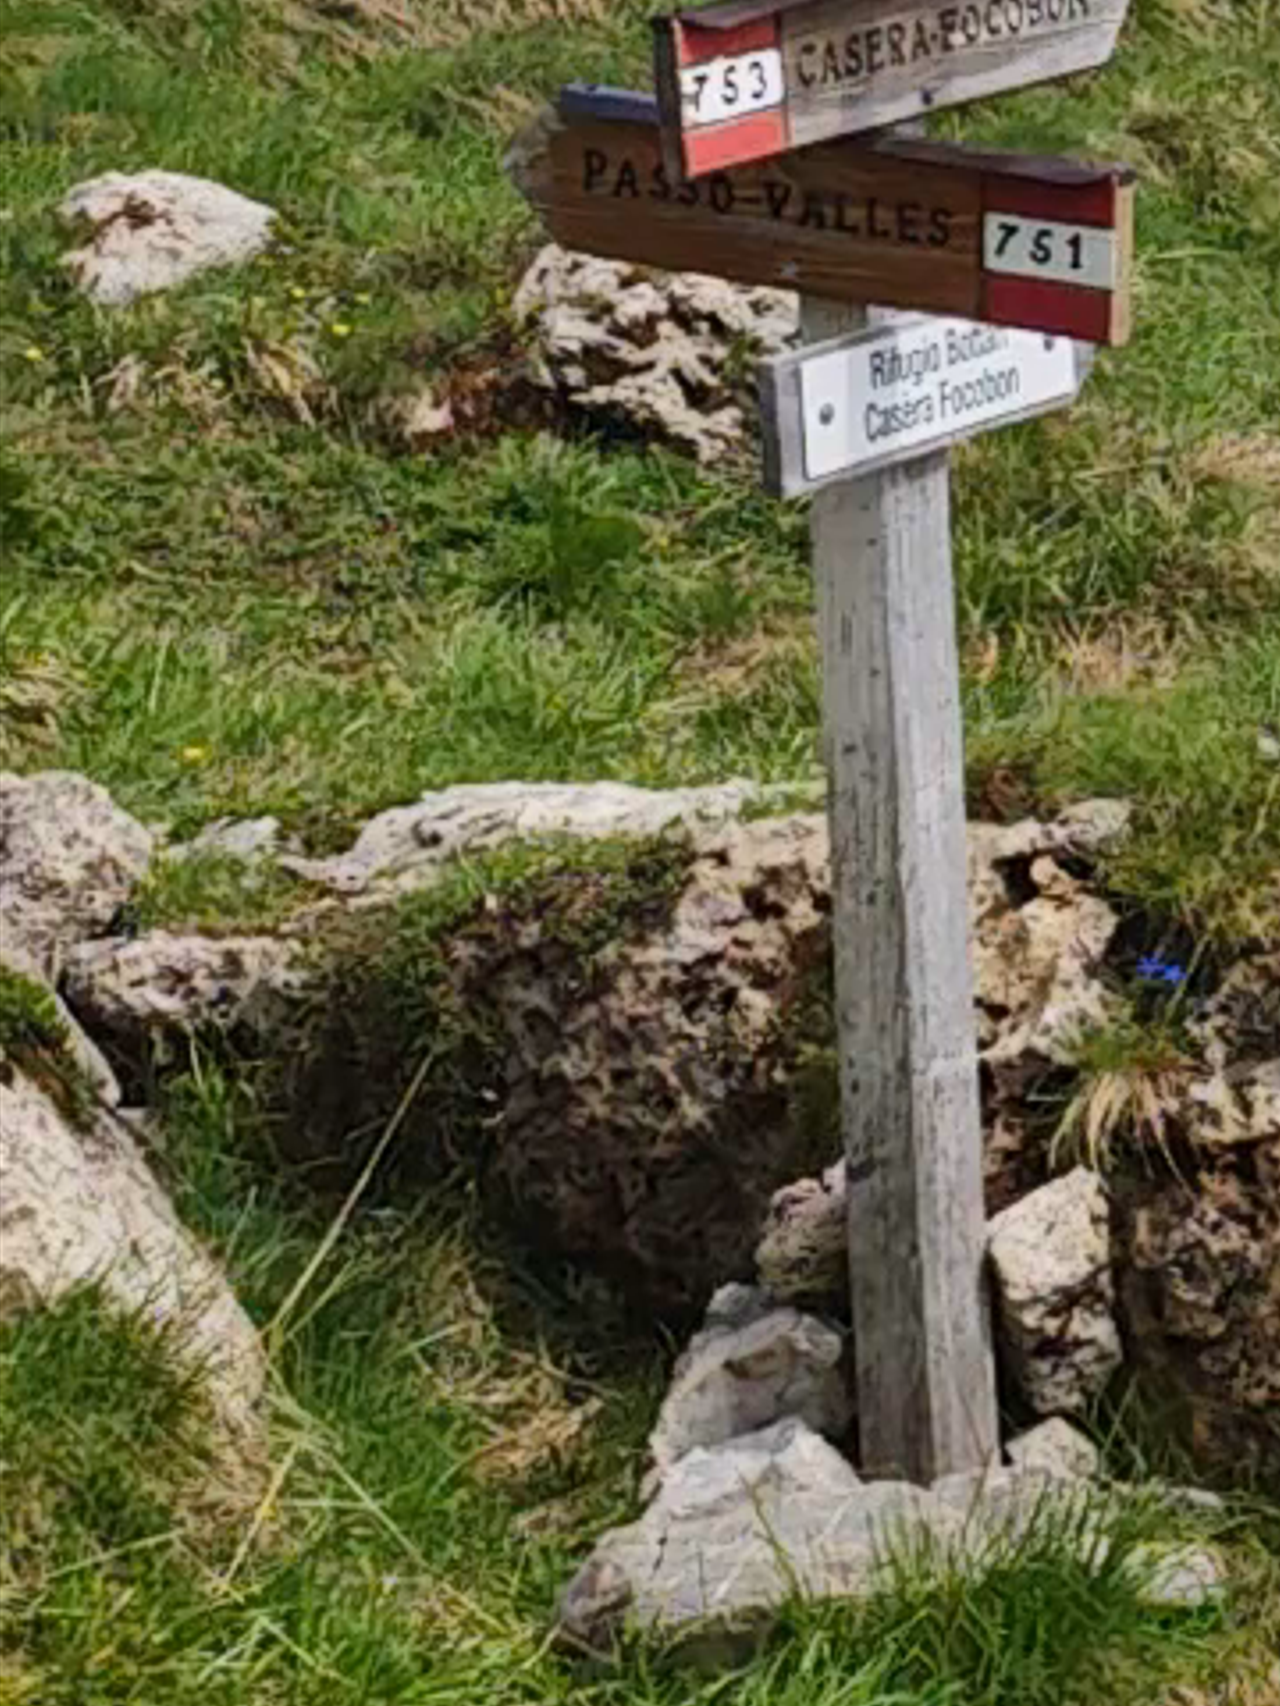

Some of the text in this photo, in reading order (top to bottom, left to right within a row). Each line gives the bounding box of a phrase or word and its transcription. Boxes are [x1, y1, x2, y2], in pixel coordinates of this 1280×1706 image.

[690, 60, 769, 114] 753
[992, 221, 1087, 271] 751
[868, 338, 941, 390] Rifugio
[939, 365, 1021, 420] Focobon
